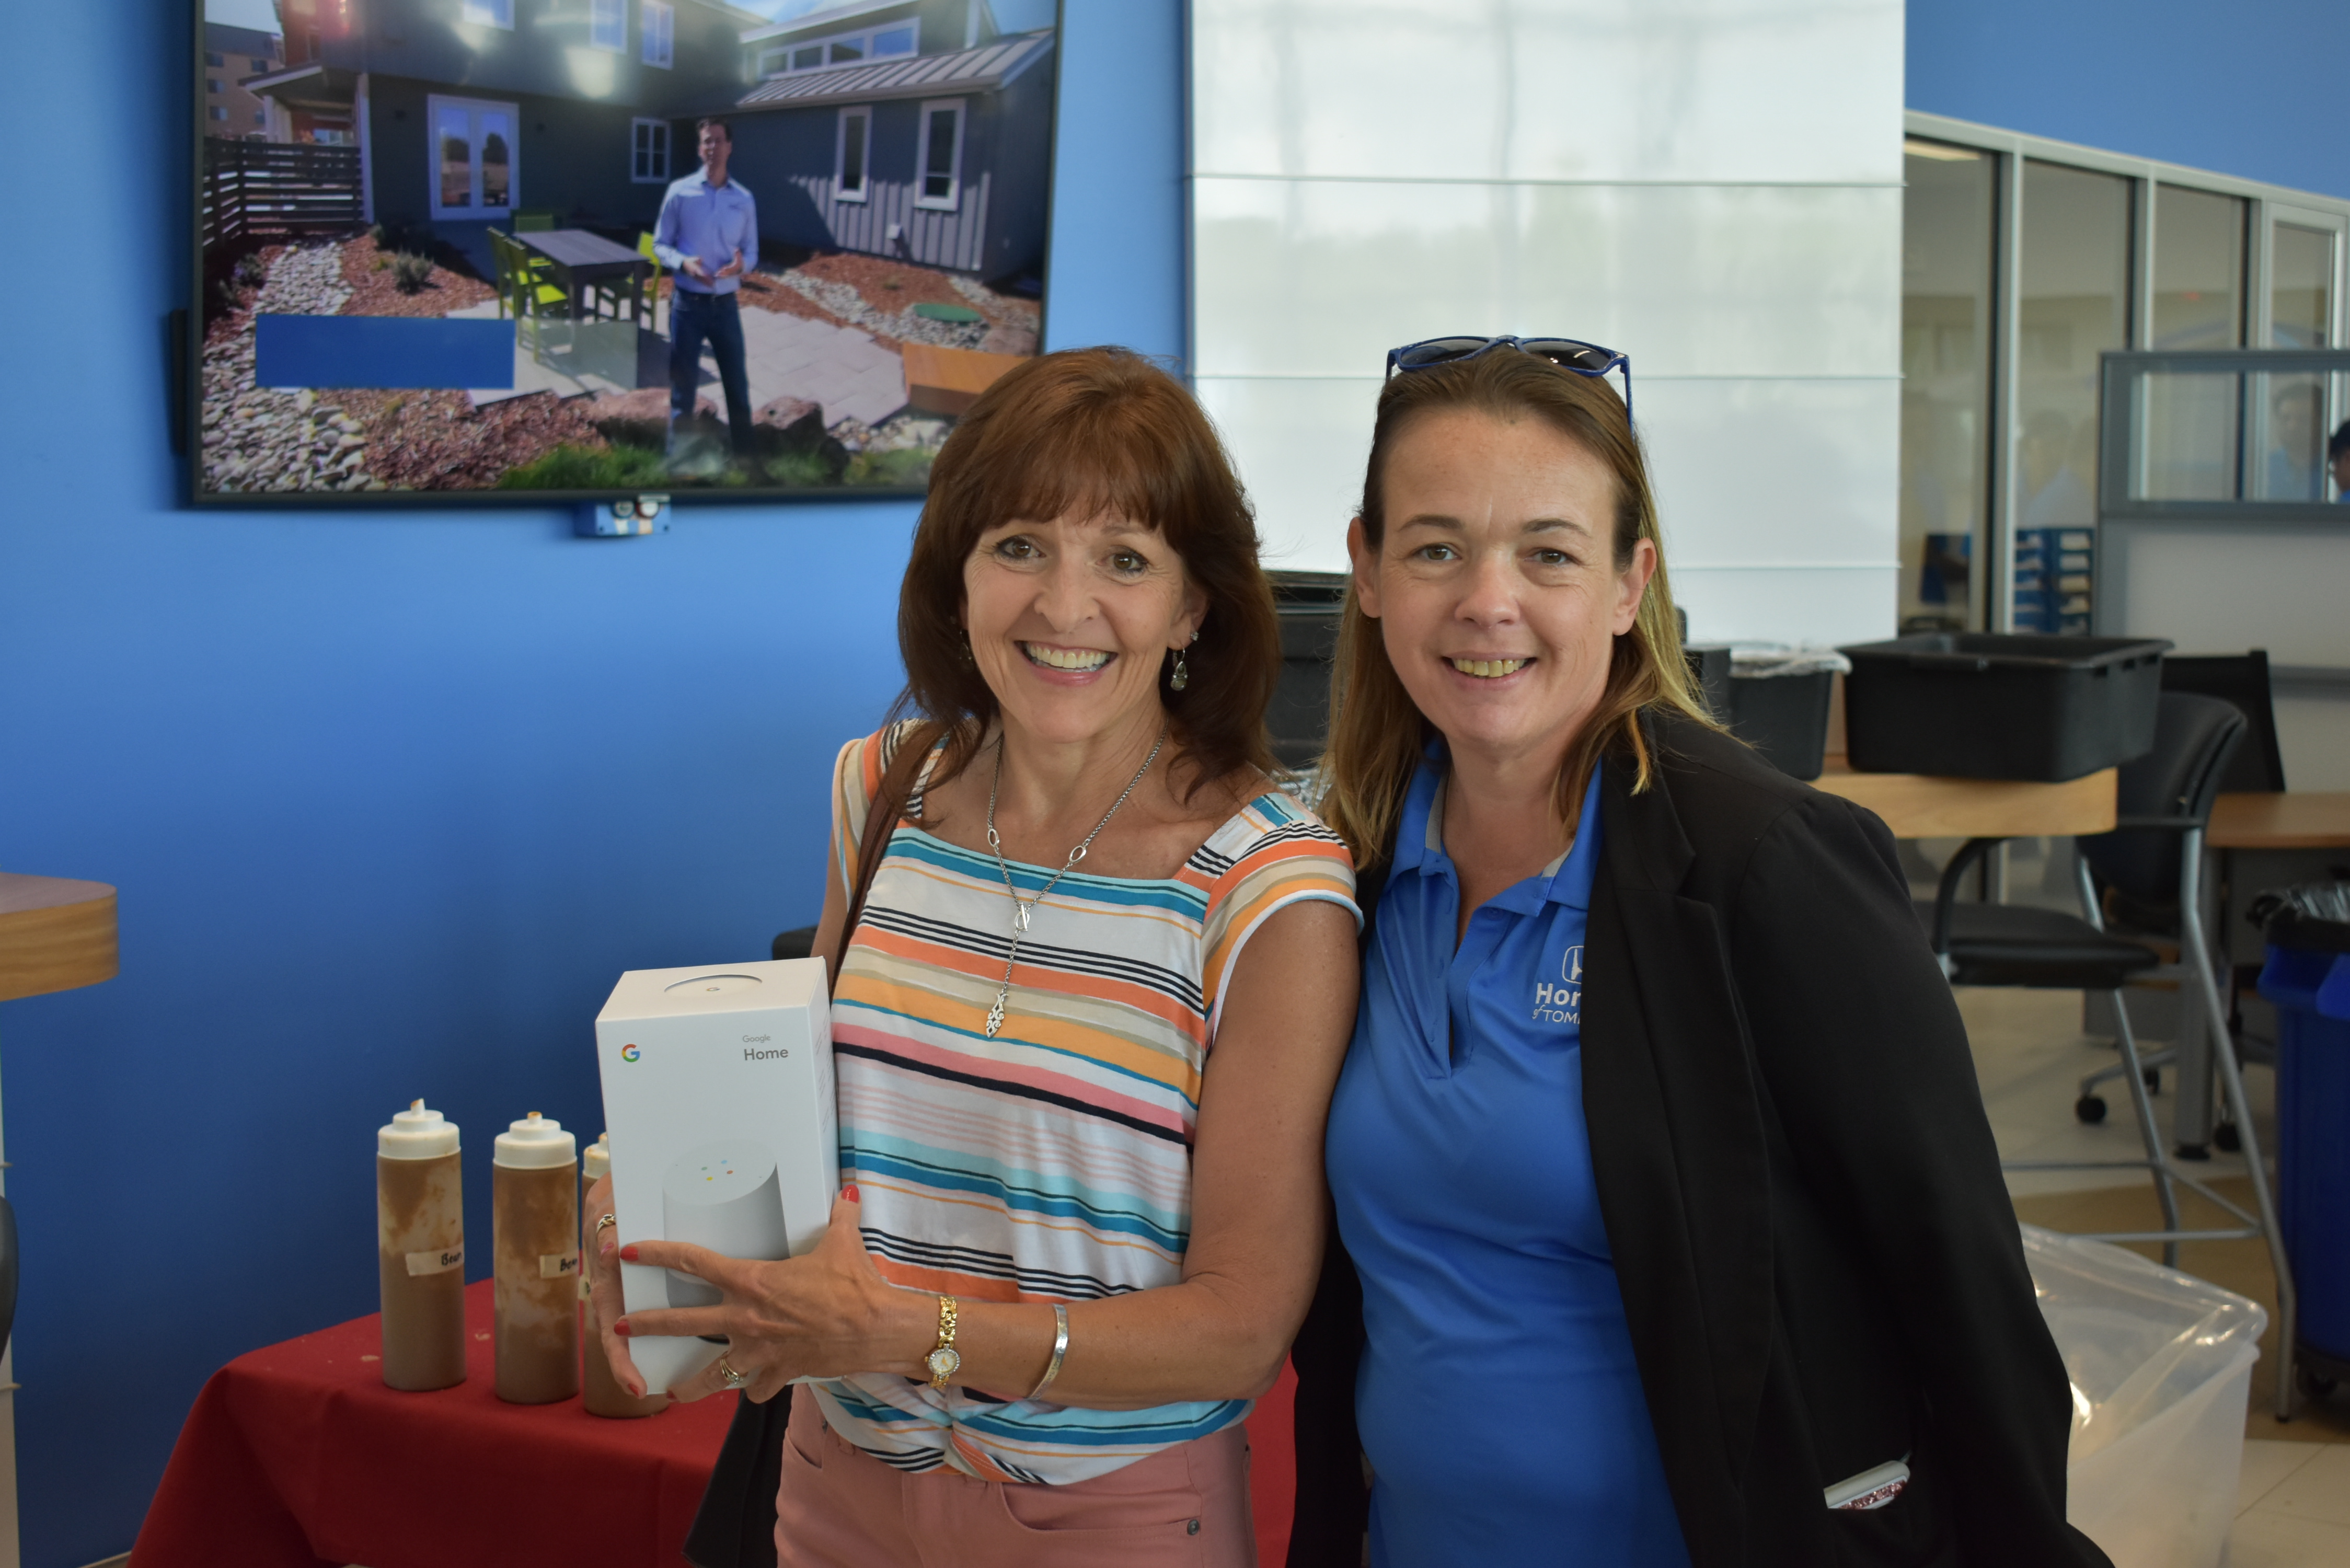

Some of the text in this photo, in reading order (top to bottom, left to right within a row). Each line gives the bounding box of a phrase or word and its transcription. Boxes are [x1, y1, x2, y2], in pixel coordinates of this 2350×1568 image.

[1542, 1009, 1580, 1024] TOM
[742, 1034, 771, 1043] Google
[621, 1044, 640, 1063] G
[744, 1048, 789, 1061] Home
